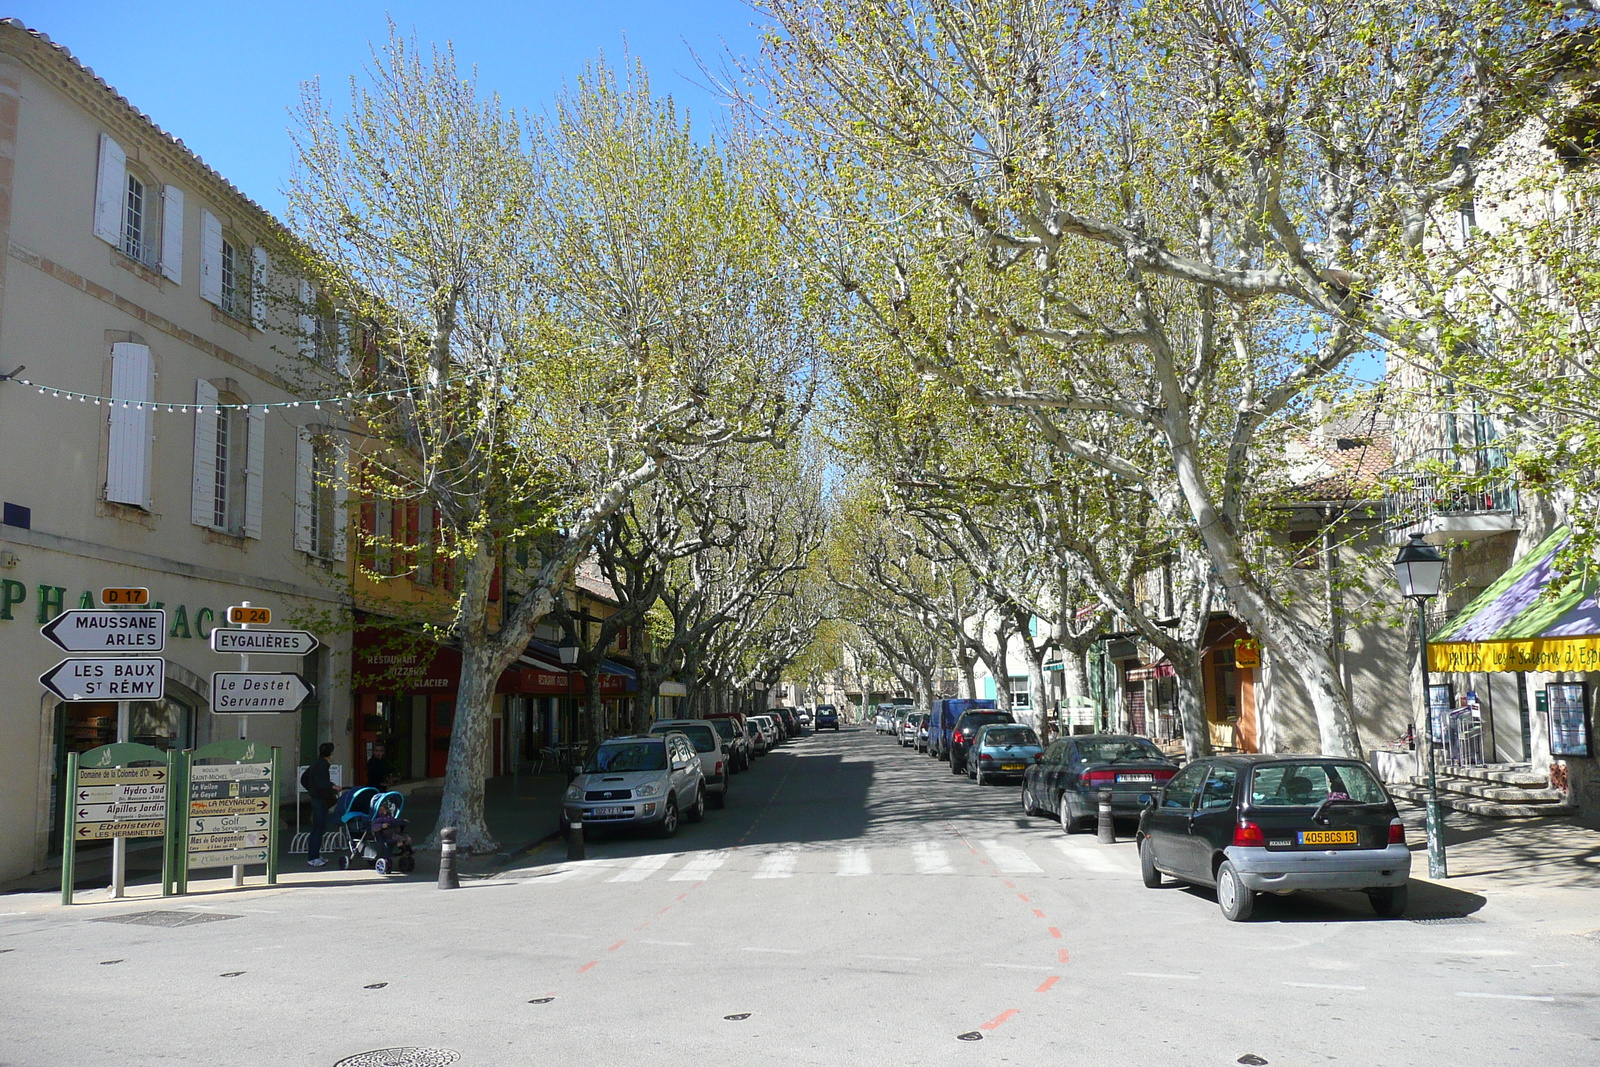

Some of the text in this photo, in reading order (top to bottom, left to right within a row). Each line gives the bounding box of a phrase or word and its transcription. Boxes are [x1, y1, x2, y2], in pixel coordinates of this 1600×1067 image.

[110, 591, 141, 602] D 17
[234, 610, 266, 621] D 24
[76, 617, 157, 628] MAUSSANE
[106, 634, 156, 645] ARLES
[221, 634, 299, 648] EYGALIÈRES
[1493, 649, 1507, 665] Les
[1509, 650, 1515, 664] 4
[1518, 648, 1561, 665] Saisons
[75, 665, 155, 677] LES BAUX
[110, 680, 154, 693] RÉMY
[221, 679, 290, 690] Le Destet
[414, 679, 448, 687] GLACIER
[220, 695, 284, 707] Servanne
[103, 770, 110, 778] de
[111, 770, 116, 778] la
[117, 769, 138, 778] Colombe
[140, 769, 150, 777] d'Or
[124, 785, 164, 796] Hydro Sud
[107, 803, 164, 814] Alpilles Jardin
[99, 821, 160, 830] Ebénisterie
[221, 817, 239, 825] Golf
[112, 829, 164, 837] HERMINETTES
[1305, 832, 1354, 842] 405 BCS 13
